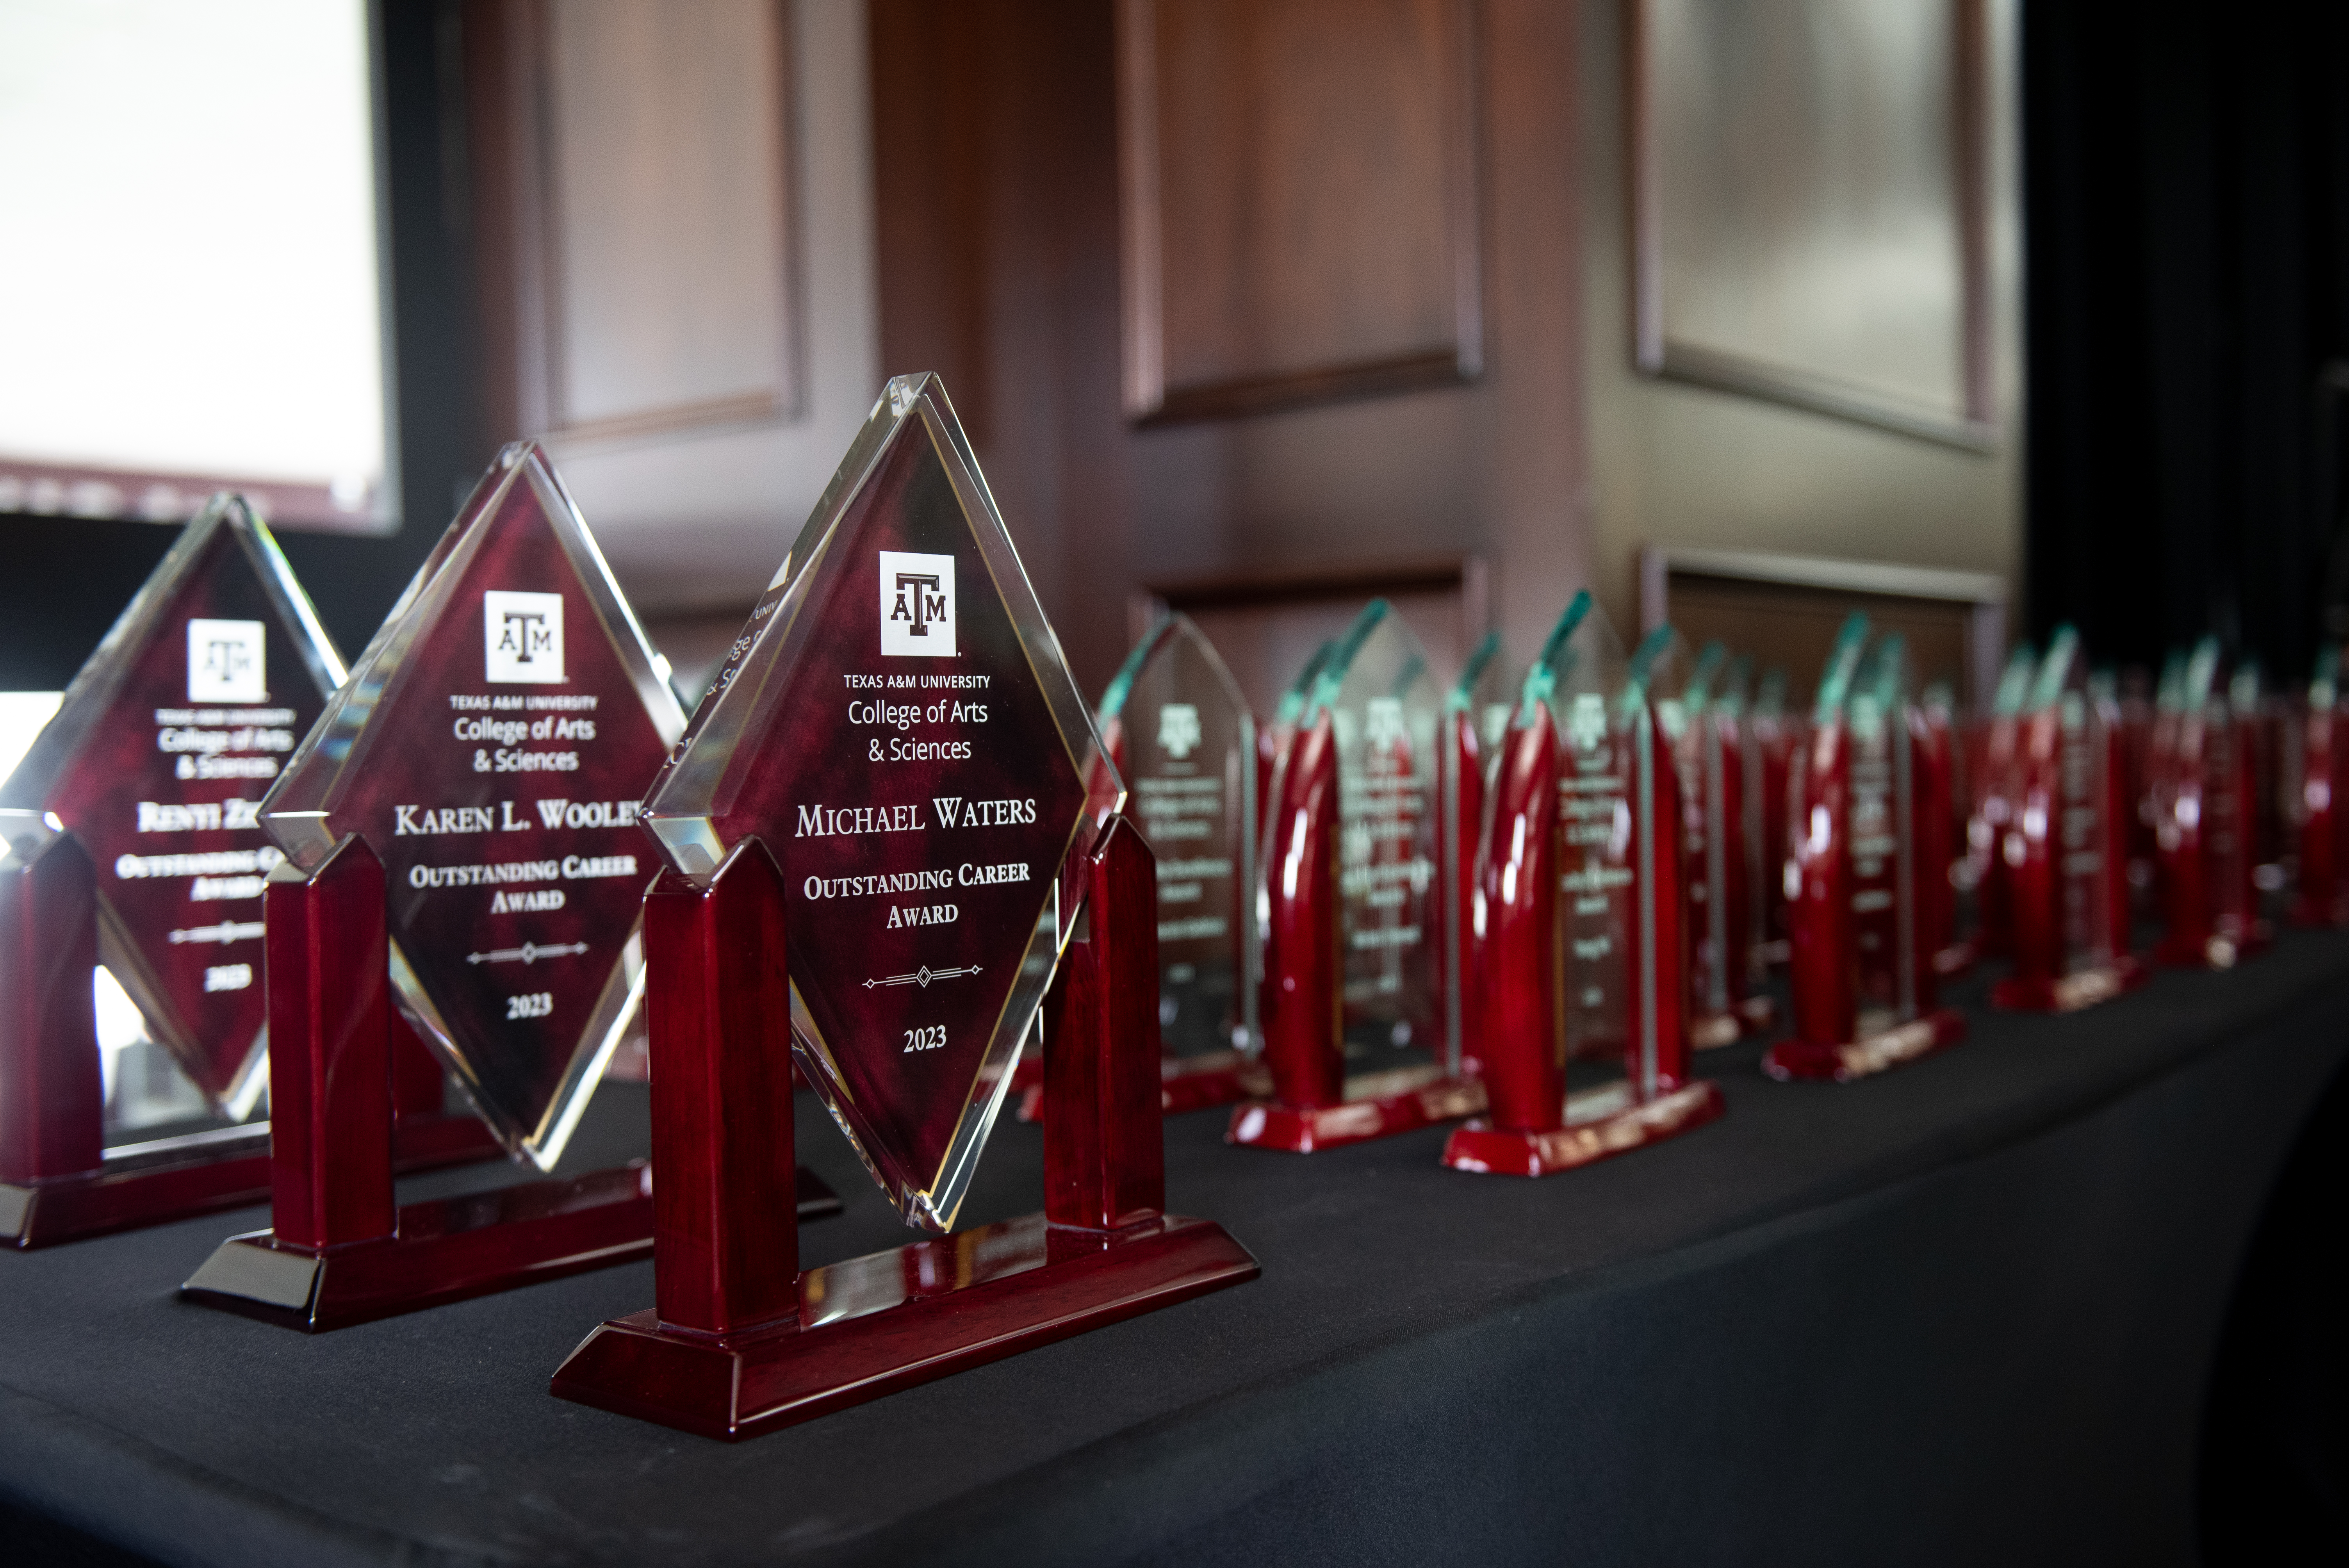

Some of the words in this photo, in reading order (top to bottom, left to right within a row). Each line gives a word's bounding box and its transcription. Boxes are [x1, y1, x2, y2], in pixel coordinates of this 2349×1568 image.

[843, 675, 883, 688] TEXAS
[888, 675, 916, 688] A&M
[921, 675, 990, 688] UNIVERSITY
[450, 695, 490, 709] TEXAS
[493, 696, 523, 709] A&M
[526, 696, 597, 710] UNIVERSITY
[849, 700, 921, 730] College
[927, 699, 946, 723] of
[950, 700, 987, 722] Arts
[454, 717, 529, 746] College
[531, 716, 553, 739] of
[554, 717, 595, 739] Arts
[474, 749, 491, 772] &
[495, 749, 579, 772] Sciences
[869, 739, 885, 761] &
[890, 738, 971, 761] Sciences
[396, 805, 493, 835] KAREN
[502, 801, 531, 831] L.
[795, 804, 925, 837] MICHAEL
[933, 797, 1035, 828] WATERS
[410, 860, 559, 888] OUTSTANDING
[562, 855, 636, 878] CAREER
[804, 870, 953, 900] OUTSTANDING
[959, 863, 1030, 886] CAREER
[492, 890, 565, 913] AWARD
[887, 904, 958, 928] AWARD
[508, 992, 552, 1019] 2023
[904, 1025, 946, 1052] 2023
